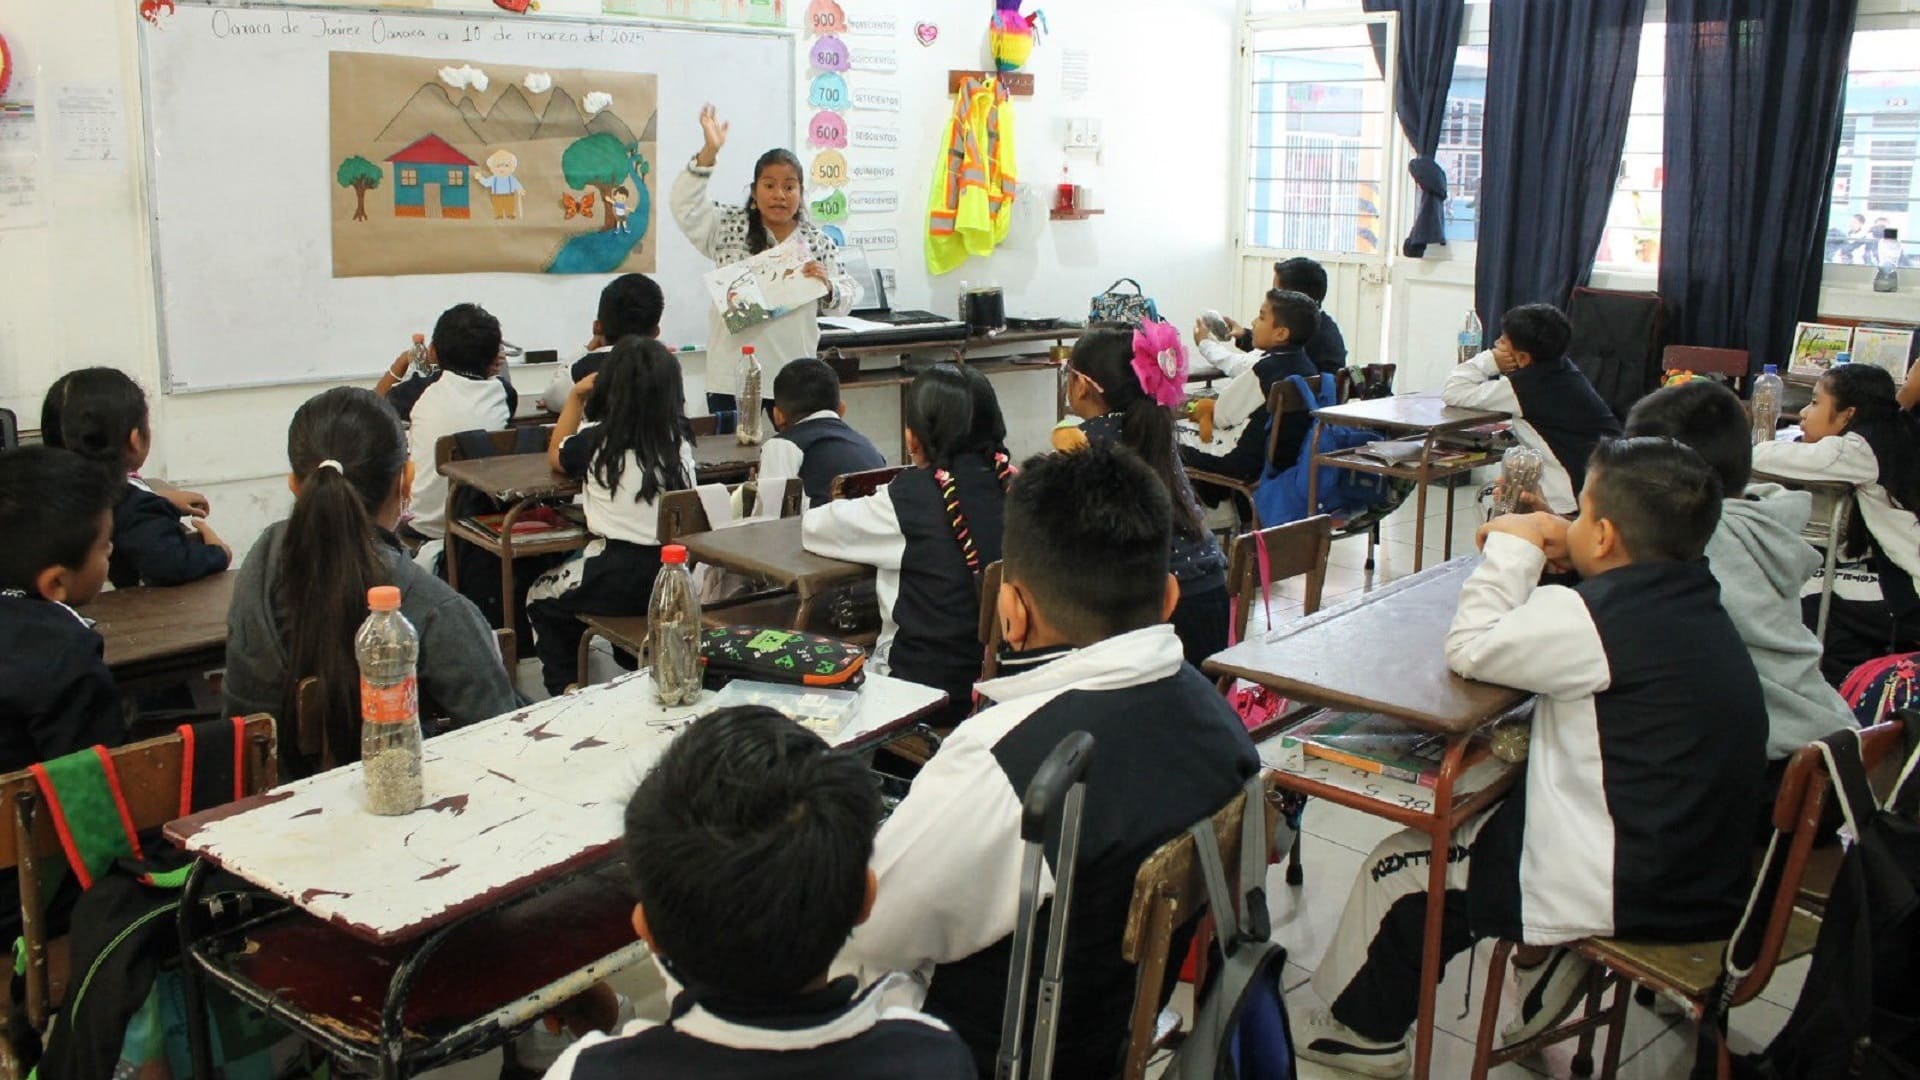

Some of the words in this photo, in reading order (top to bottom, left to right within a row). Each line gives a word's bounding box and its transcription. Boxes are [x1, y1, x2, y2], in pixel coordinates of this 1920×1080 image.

[212, 10, 271, 38] Oaxaca
[281, 12, 299, 35] de
[372, 17, 425, 44] Oaxaca
[437, 32, 449, 41] a
[461, 26, 481, 42] 10
[493, 26, 513, 41] de
[584, 29, 604, 43] del
[812, 13, 835, 27] 900
[817, 52, 839, 66] 800
[819, 88, 840, 102] 700
[816, 126, 839, 140] 600
[819, 165, 840, 178] 500
[818, 201, 839, 215] 400
